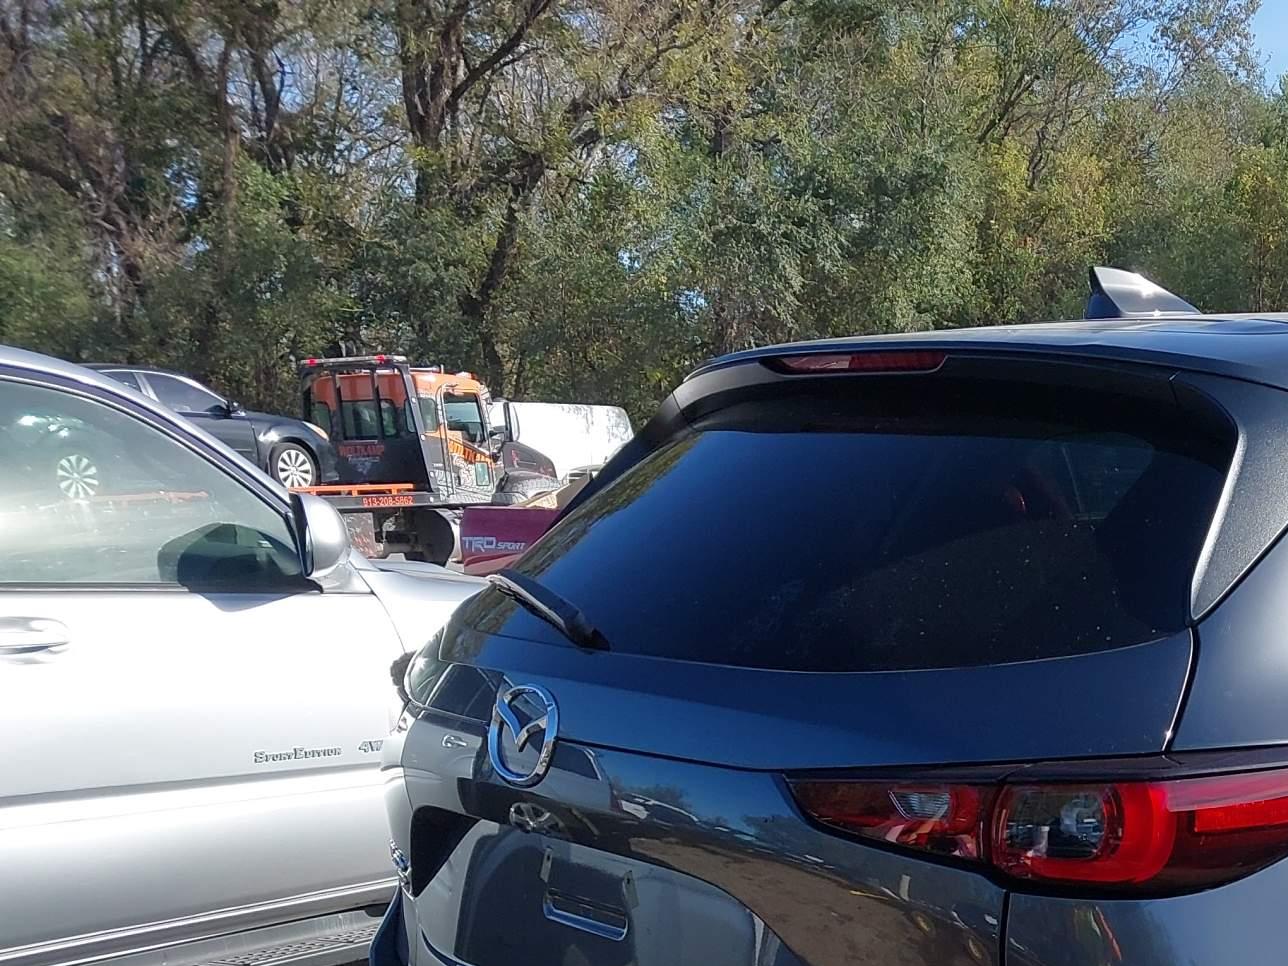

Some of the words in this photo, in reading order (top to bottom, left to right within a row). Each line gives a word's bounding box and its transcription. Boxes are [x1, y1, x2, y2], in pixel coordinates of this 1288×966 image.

[461, 536, 496, 552] TRD
[496, 542, 526, 550] SPORT
[358, 739, 384, 753] 4W
